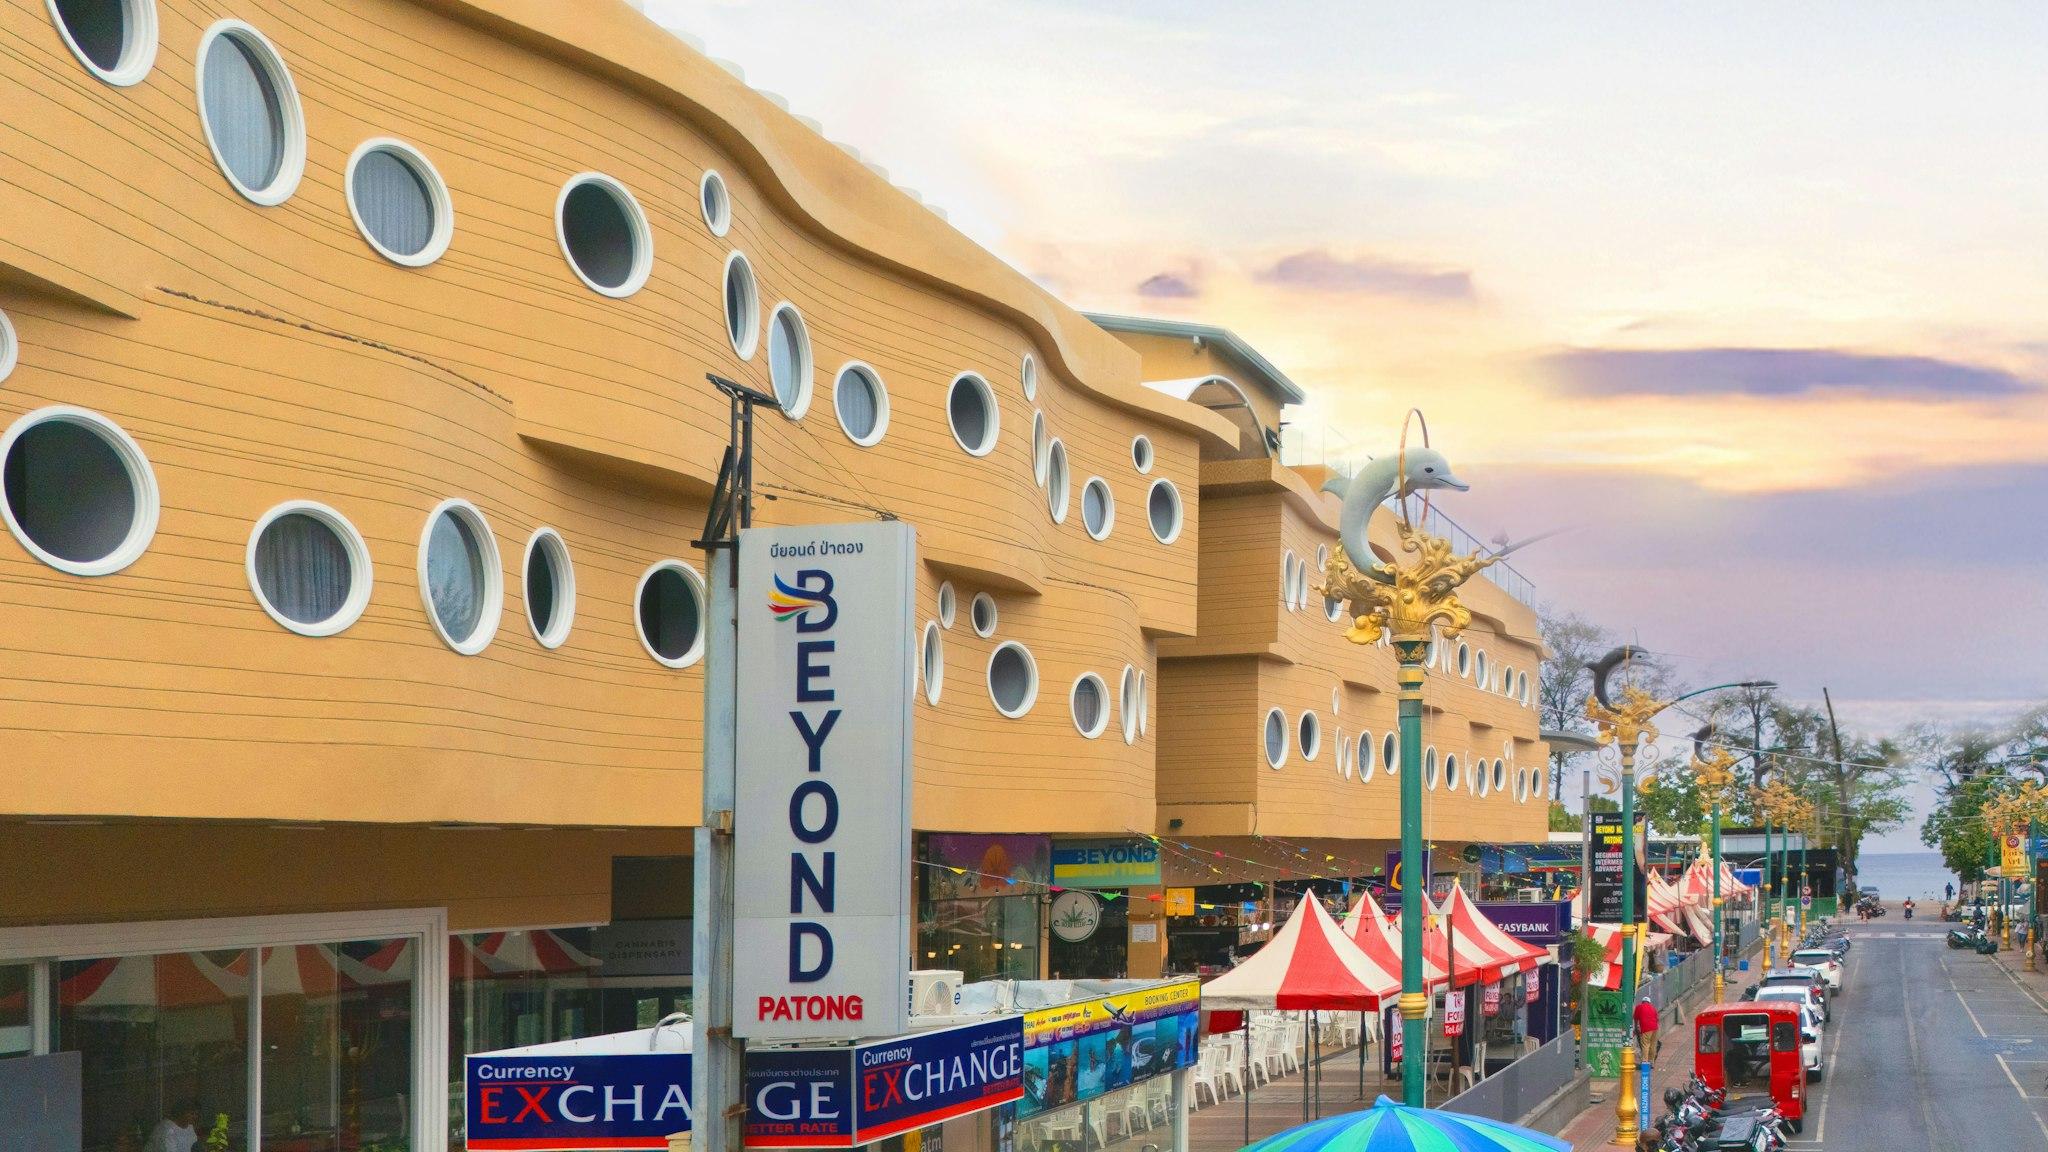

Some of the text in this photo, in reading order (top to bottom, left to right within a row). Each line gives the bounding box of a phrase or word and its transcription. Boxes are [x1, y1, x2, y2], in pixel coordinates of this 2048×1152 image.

[820, 540, 864, 555] ป่าตอง
[788, 569, 842, 983] BEYOND
[1074, 846, 1157, 865] BEYOND
[1499, 924, 1549, 932] EASYBANK
[1144, 988, 1189, 1005] BOOKING CENTER
[759, 995, 863, 1021] PATONG
[863, 1047, 912, 1067] Currency
[478, 1064, 575, 1081] Currency
[864, 1043, 1021, 1113] EXCHANGE
[800, 1123, 838, 1133] RATE
